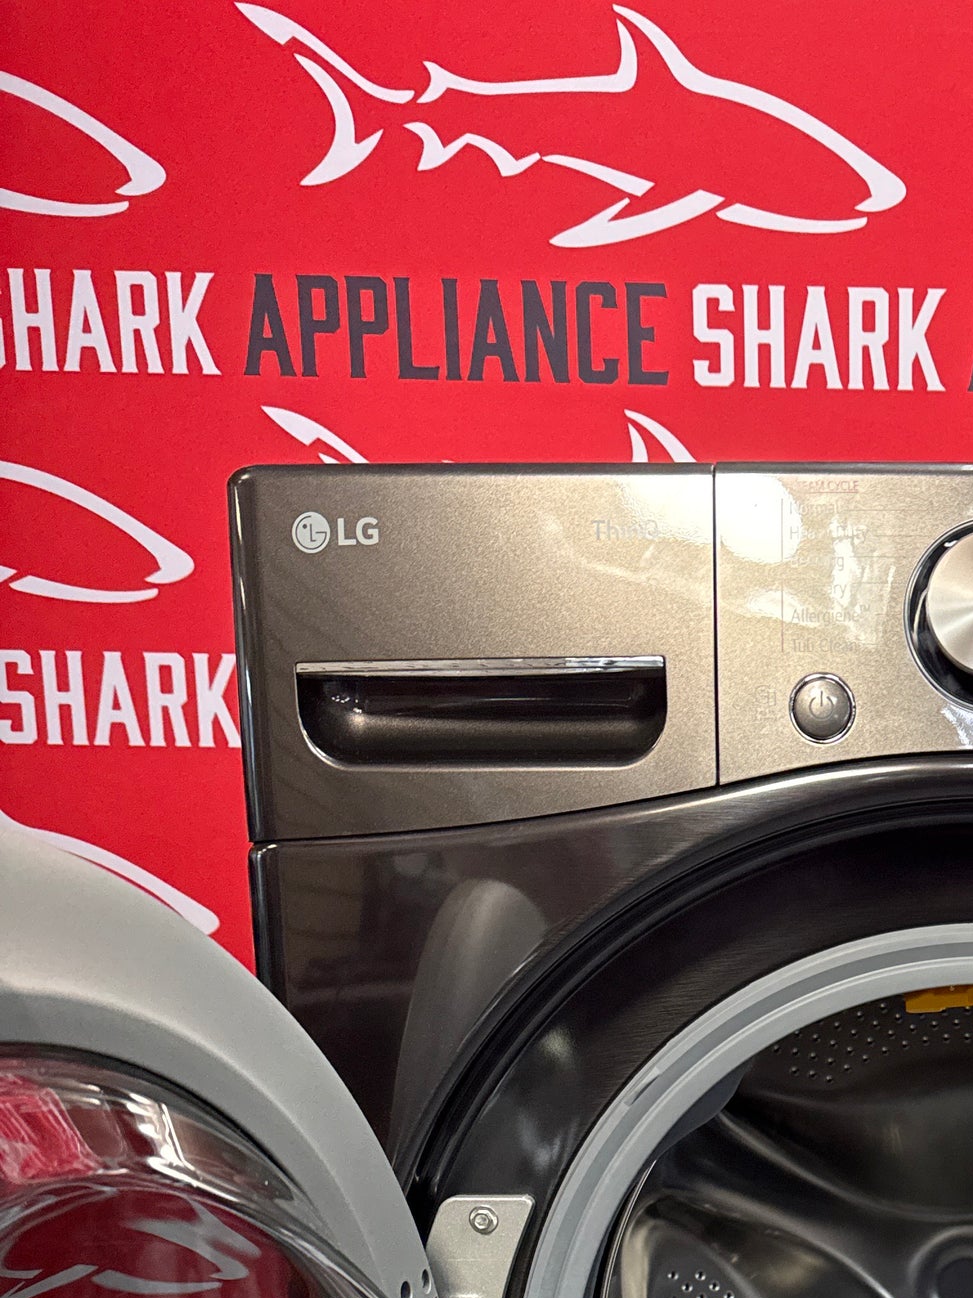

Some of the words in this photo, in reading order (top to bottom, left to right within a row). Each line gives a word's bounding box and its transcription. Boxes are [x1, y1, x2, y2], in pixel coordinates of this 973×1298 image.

[0, 268, 222, 375] HARK
[243, 273, 669, 386] APPLIANCE
[692, 284, 946, 392] SHARK
[337, 516, 380, 546] LG
[0, 649, 242, 748] SHARK
